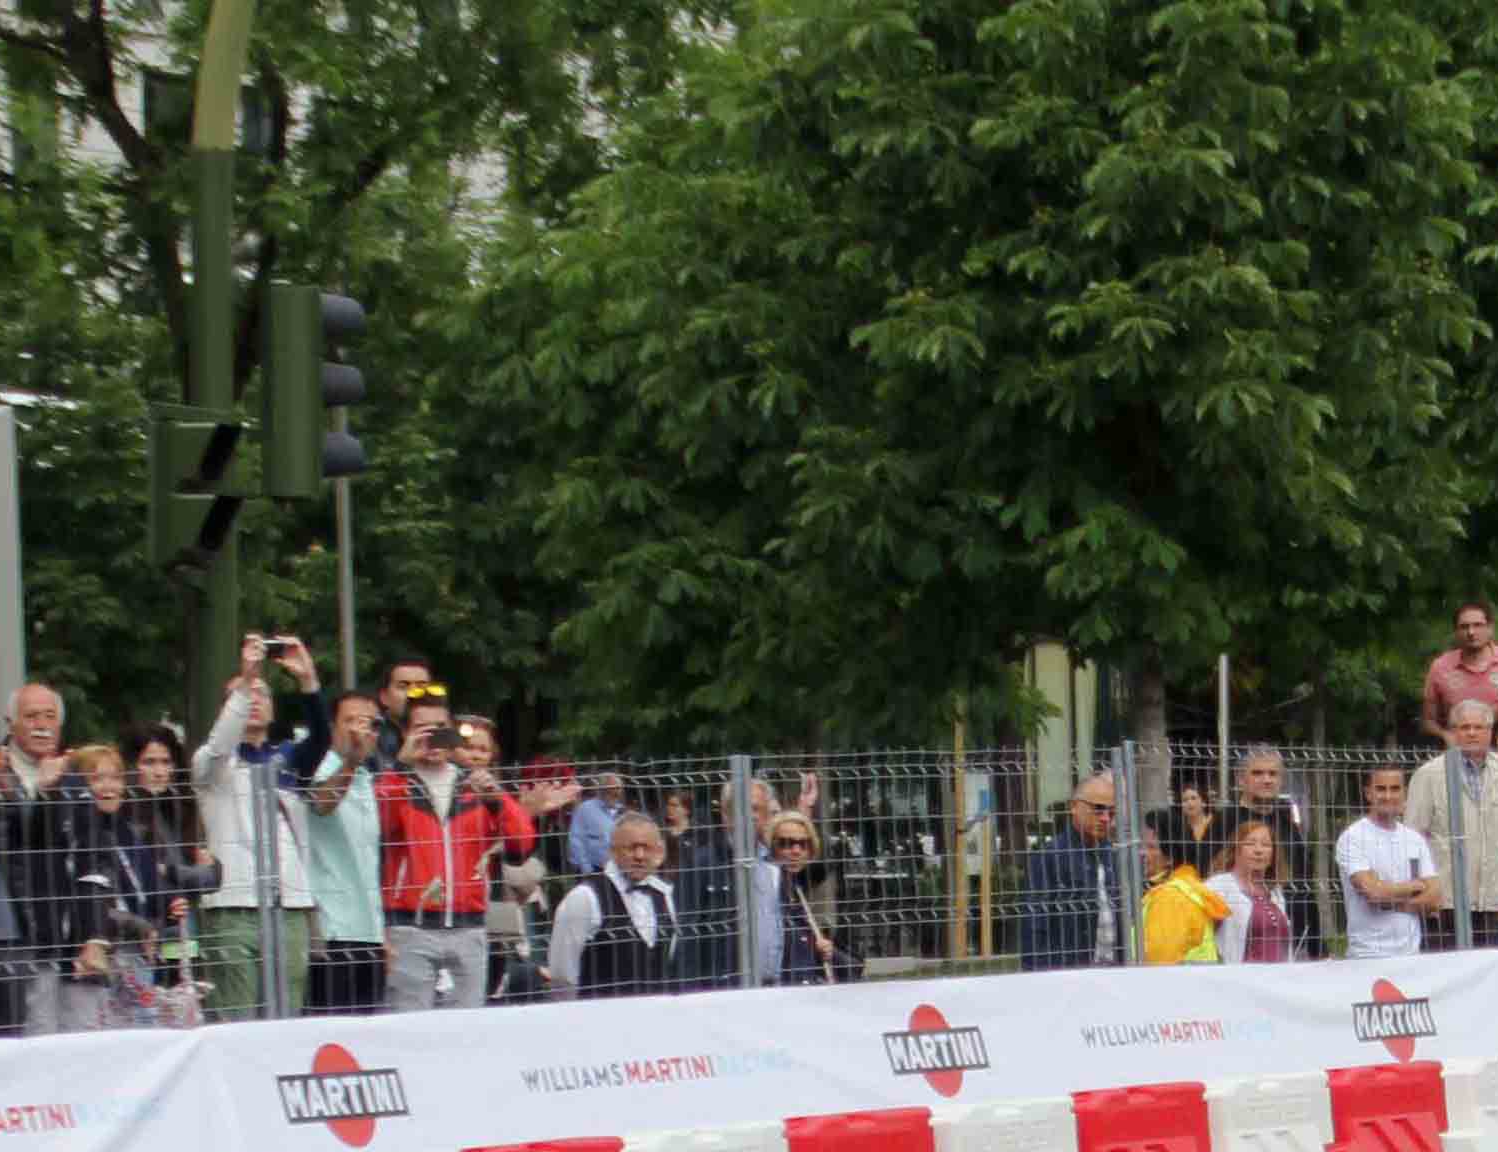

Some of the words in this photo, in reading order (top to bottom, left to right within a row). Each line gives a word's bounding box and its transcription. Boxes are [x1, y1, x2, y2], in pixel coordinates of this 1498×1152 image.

[1353, 1001, 1435, 1039] MARTINI
[885, 1031, 987, 1070] MARTINI
[280, 1072, 407, 1118] MARTINI
